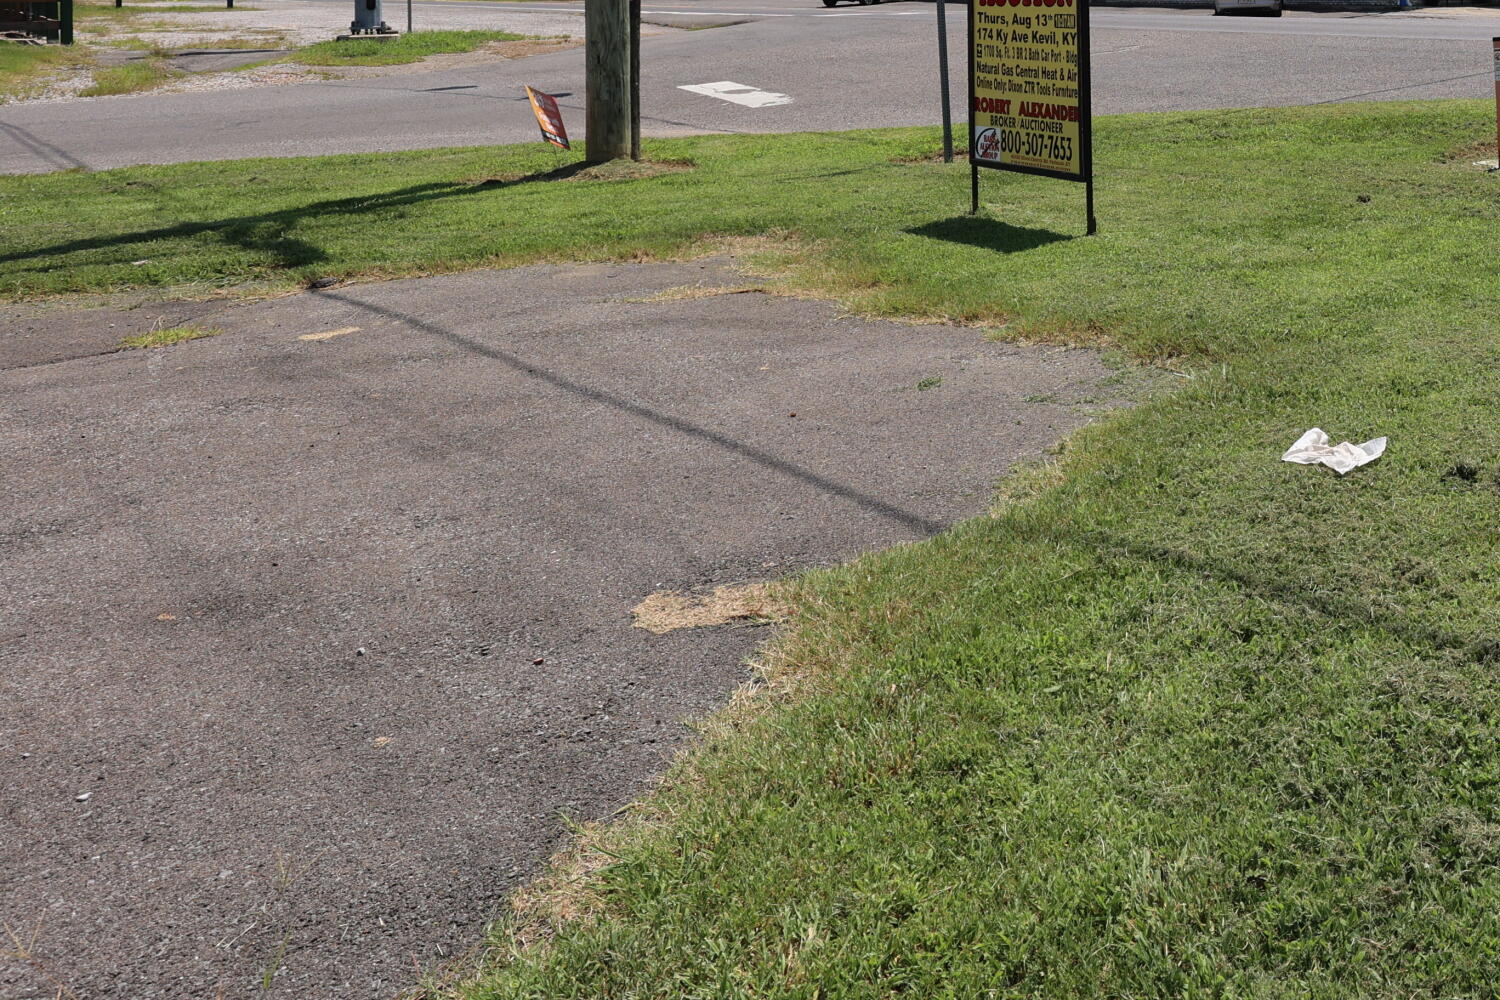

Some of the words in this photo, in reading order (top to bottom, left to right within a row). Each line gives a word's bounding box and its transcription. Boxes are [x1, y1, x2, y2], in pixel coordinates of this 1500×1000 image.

[977, 11, 1009, 27] Thurs,
[1011, 13, 1031, 29] Aug
[1035, 13, 1053, 27] 13th
[976, 27, 994, 41] 174
[996, 28, 1009, 45] Ky
[1011, 29, 1029, 44] Ave
[1031, 30, 1059, 48] Kevil,
[1062, 31, 1077, 46] KY
[1016, 46, 1023, 60] BR
[1028, 47, 1040, 62] Bath
[1040, 48, 1050, 62] Car
[1050, 49, 1062, 63] Port
[1065, 50, 1078, 68] Bldg
[976, 60, 1000, 73] Natural
[1001, 62, 1014, 77] Gas
[1015, 64, 1040, 79] Central
[1041, 66, 1058, 81] Heat
[1059, 67, 1065, 81] &
[1067, 68, 1078, 83] Air
[976, 76, 993, 90] Online
[1008, 80, 1023, 93] Dixon
[1023, 80, 1035, 95] ZTR
[1036, 82, 1051, 96] Tools
[1051, 83, 1078, 99] Furniture
[974, 96, 1012, 115] ROBERT
[1018, 101, 1080, 122] ALEXANDER
[1000, 129, 1073, 161] 800-307-7653
